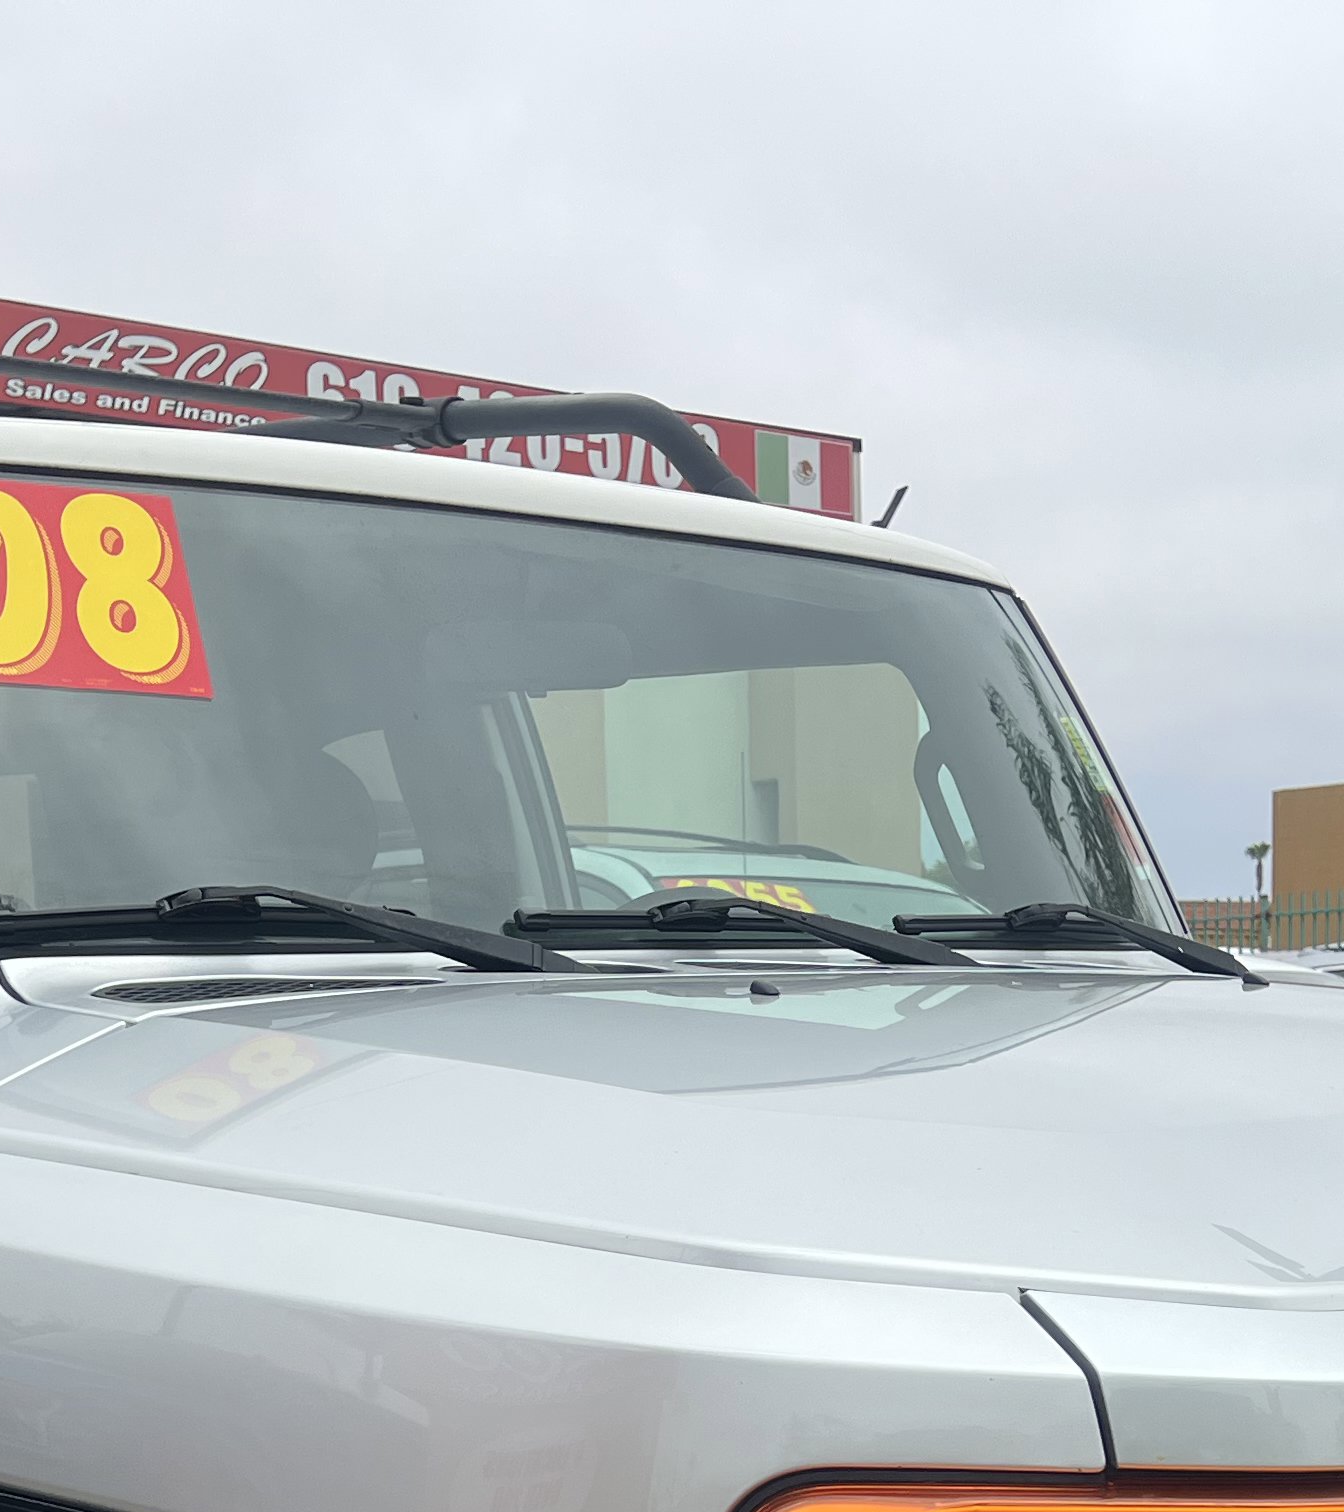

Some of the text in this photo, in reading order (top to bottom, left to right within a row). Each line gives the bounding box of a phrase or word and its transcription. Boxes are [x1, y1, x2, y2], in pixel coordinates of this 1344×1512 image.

[1, 316, 268, 390] CARCO
[5, 378, 87, 405] Sales
[96, 393, 150, 414] and
